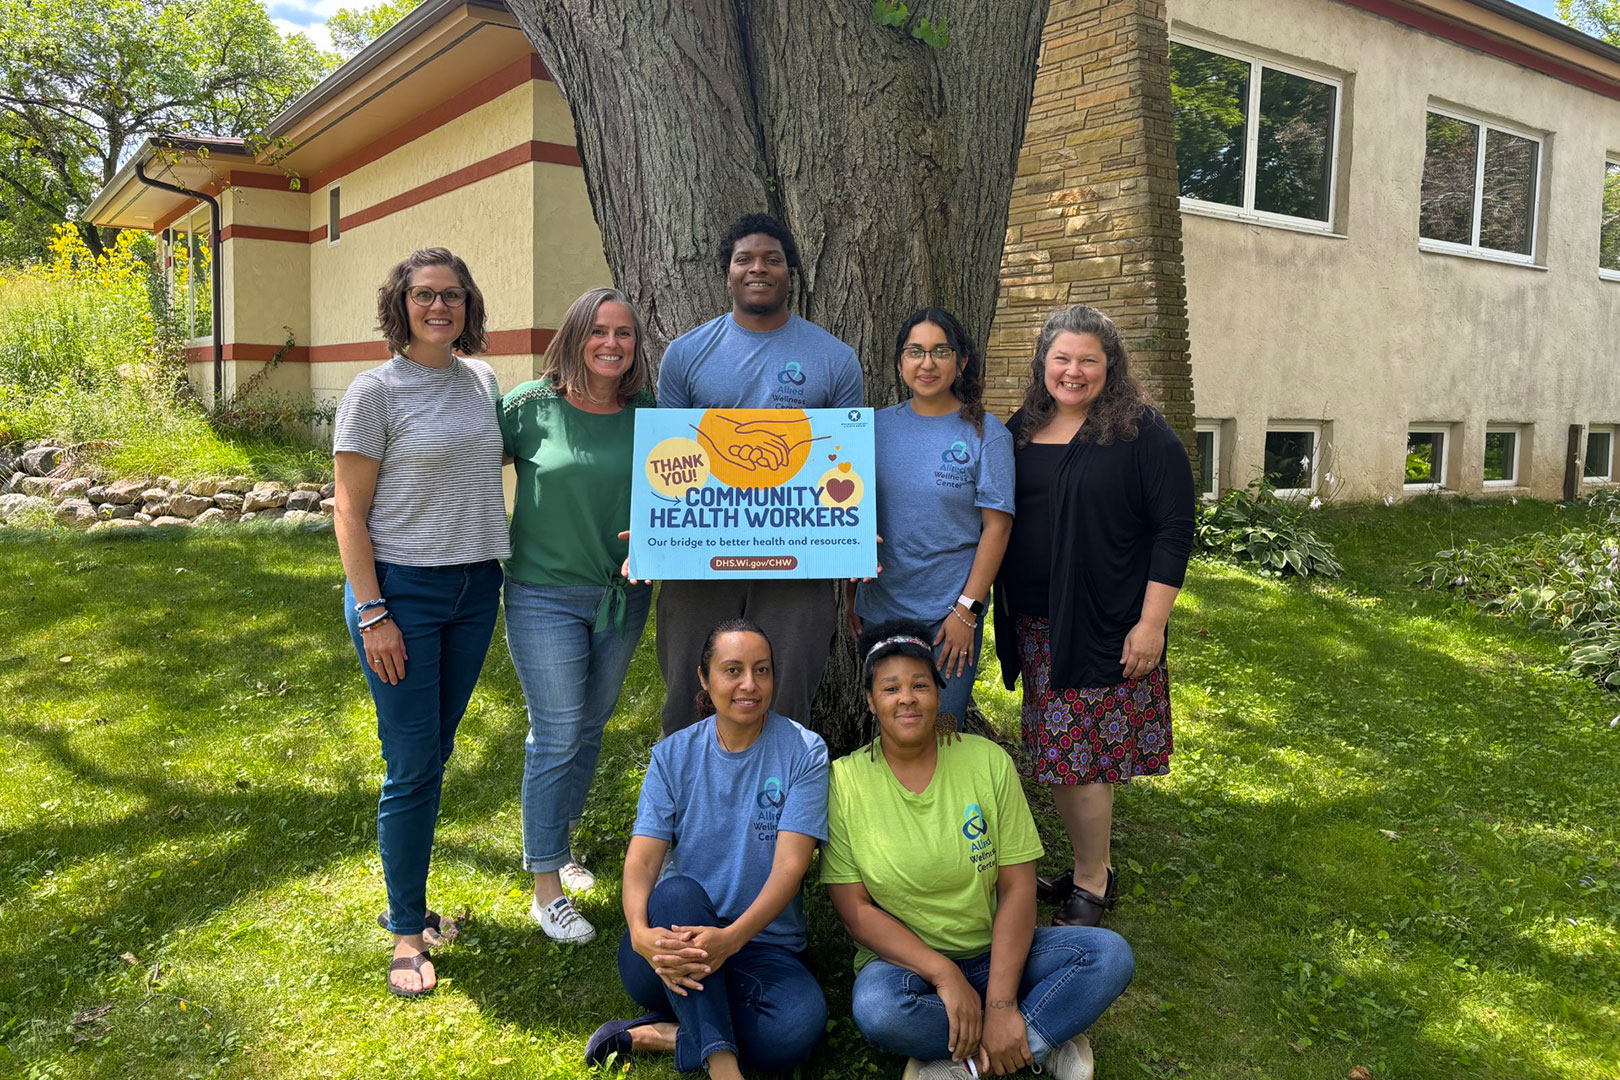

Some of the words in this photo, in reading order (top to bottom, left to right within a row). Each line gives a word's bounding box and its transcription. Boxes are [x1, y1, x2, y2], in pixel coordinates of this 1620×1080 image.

[777, 385, 804, 396] Allied
[772, 394, 806, 405] Wellness
[650, 453, 704, 474] THANK
[660, 470, 698, 487] YOU!
[934, 471, 968, 482] Wellness
[936, 479, 962, 489] Center
[685, 486, 825, 507] COMMUNITY
[650, 507, 739, 528] HEALTH
[744, 506, 860, 528] WORKERS
[647, 537, 667, 547] Our
[670, 537, 703, 549] bridge
[706, 538, 716, 546] to
[720, 537, 750, 546] better
[753, 537, 785, 546] health
[788, 536, 808, 546] and
[810, 537, 860, 546] resources.
[715, 559, 792, 569] DHS.Wi.gov/CHW
[758, 811, 782, 820] Allid
[753, 822, 778, 831] Welln
[758, 832, 777, 841] Cen
[978, 861, 995, 872] Cente
